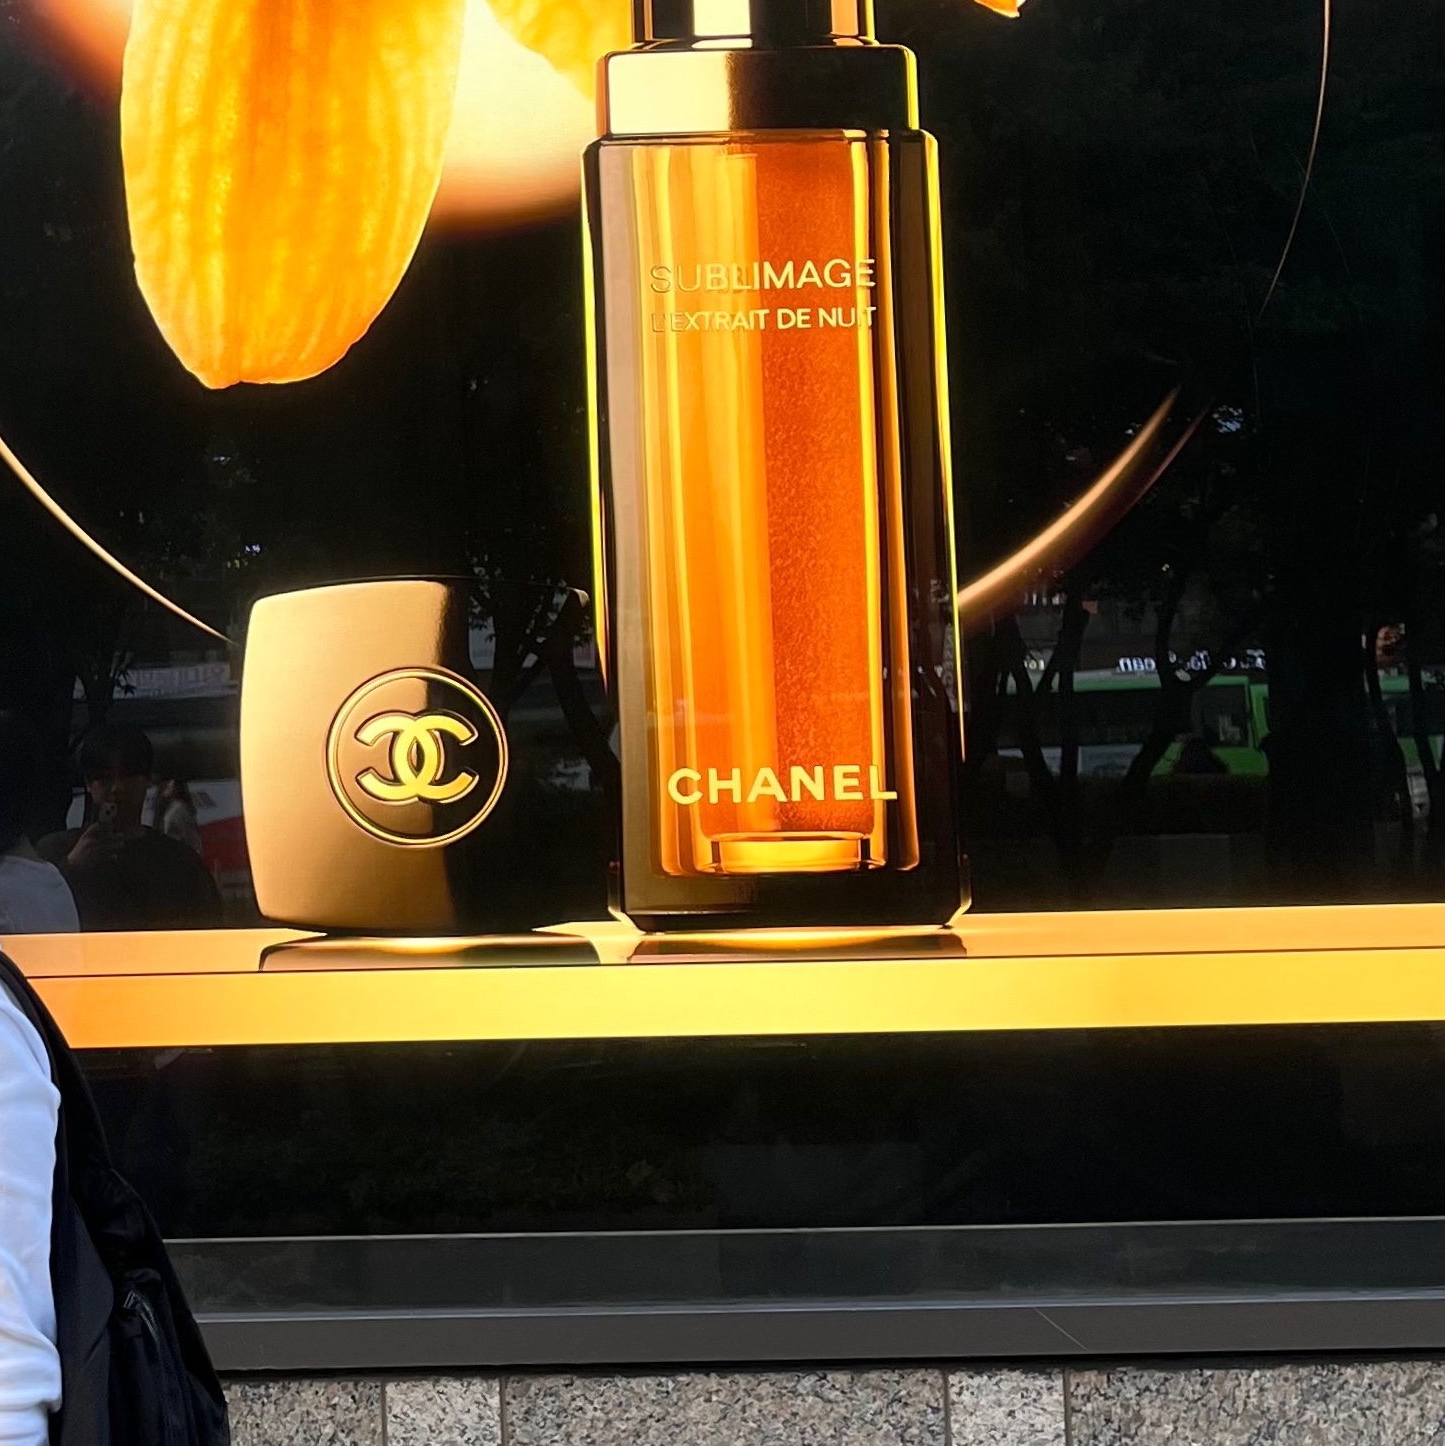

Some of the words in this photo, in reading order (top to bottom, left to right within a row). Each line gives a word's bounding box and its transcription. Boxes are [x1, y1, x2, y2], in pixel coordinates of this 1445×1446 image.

[651, 258, 876, 293] SUBLIMAGE
[777, 308, 812, 329] DE
[819, 306, 877, 328] NUIT
[667, 765, 898, 805] CHANEL
